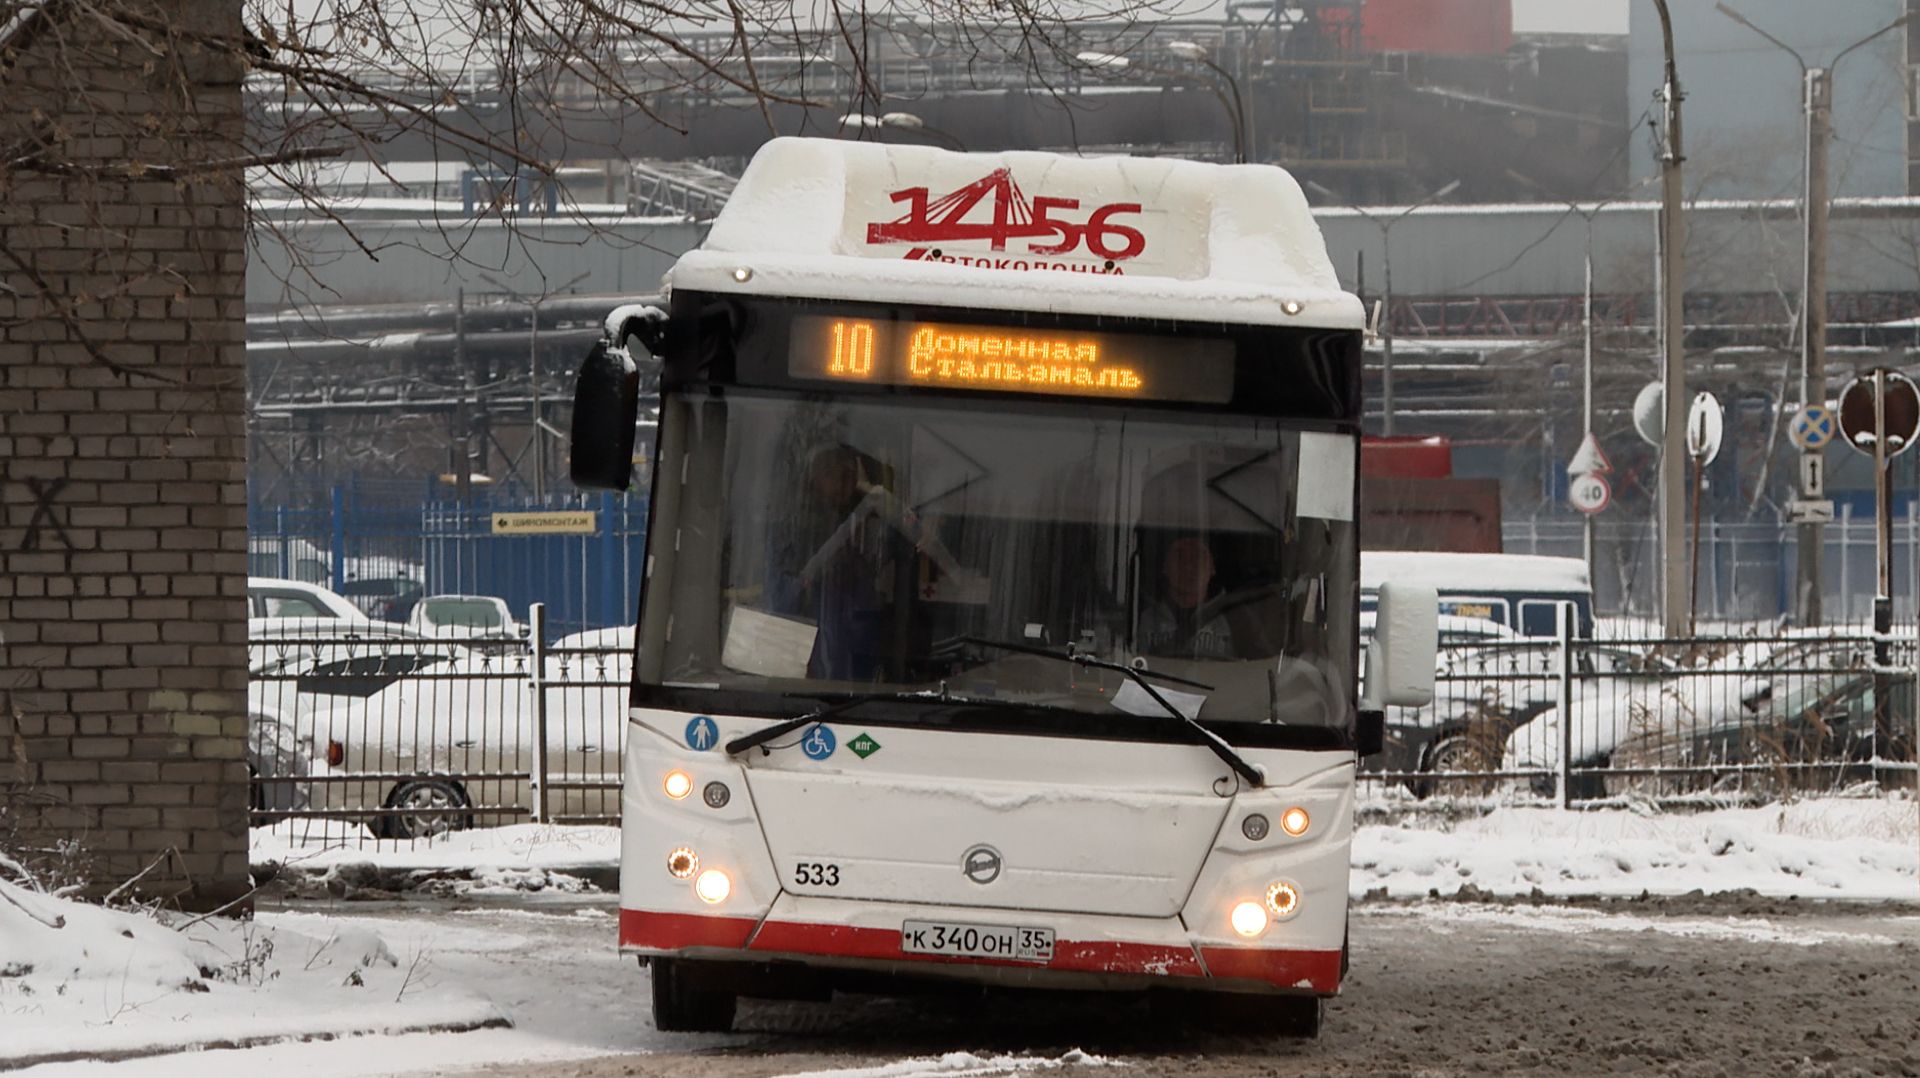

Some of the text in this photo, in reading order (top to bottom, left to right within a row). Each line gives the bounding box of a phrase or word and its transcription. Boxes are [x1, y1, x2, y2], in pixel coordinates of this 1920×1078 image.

[867, 168, 1146, 260] 1456
[831, 323, 873, 374] 10
[911, 327, 1097, 362] Доменная
[910, 350, 1142, 388] Стальэмаль
[512, 517, 589, 528] ШИНОМОНТАЖ
[855, 741, 873, 751] КПГ
[795, 863, 840, 887] 533
[1021, 930, 1045, 949] 35
